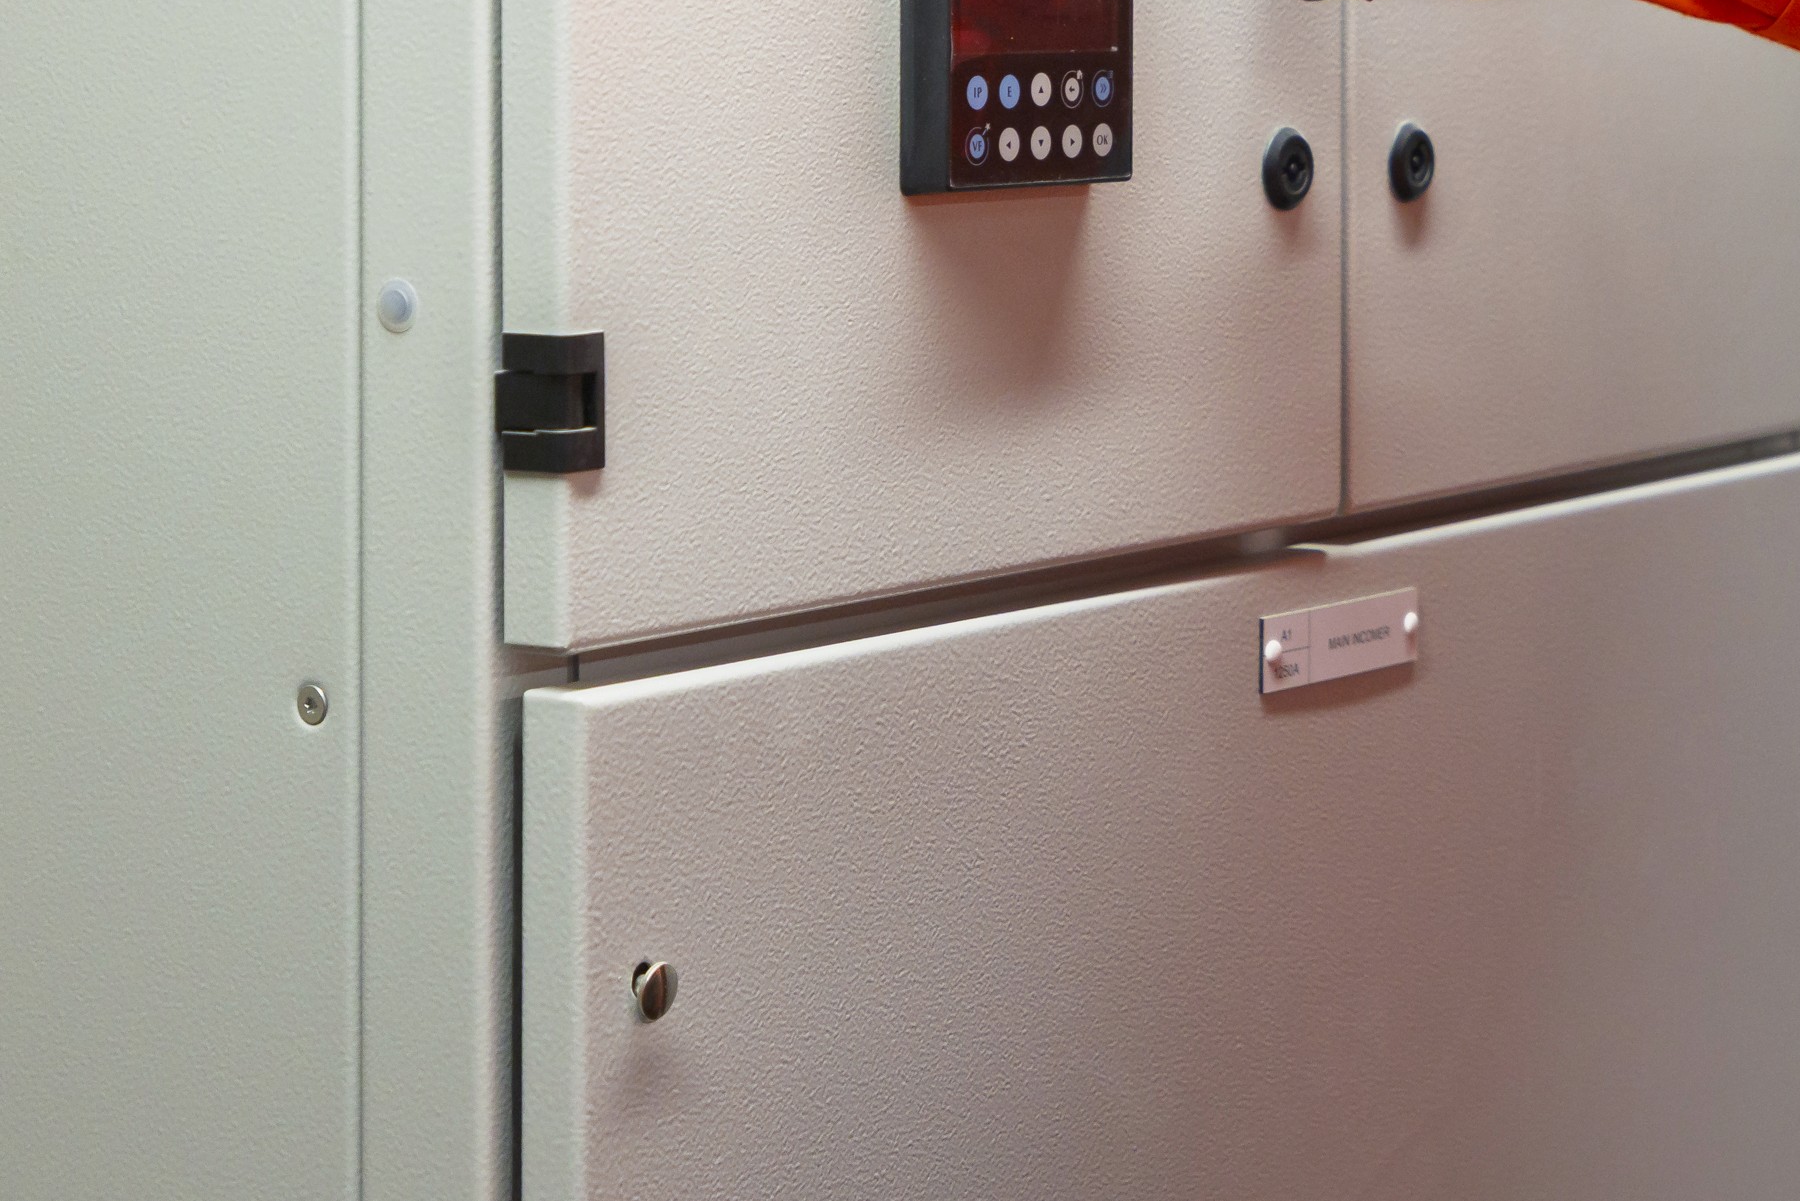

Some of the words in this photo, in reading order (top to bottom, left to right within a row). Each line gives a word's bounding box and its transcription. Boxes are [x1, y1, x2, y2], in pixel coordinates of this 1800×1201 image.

[973, 86, 983, 98] IP
[1007, 86, 1012, 98] E
[1096, 134, 1108, 146] OK
[972, 141, 983, 152] VF
